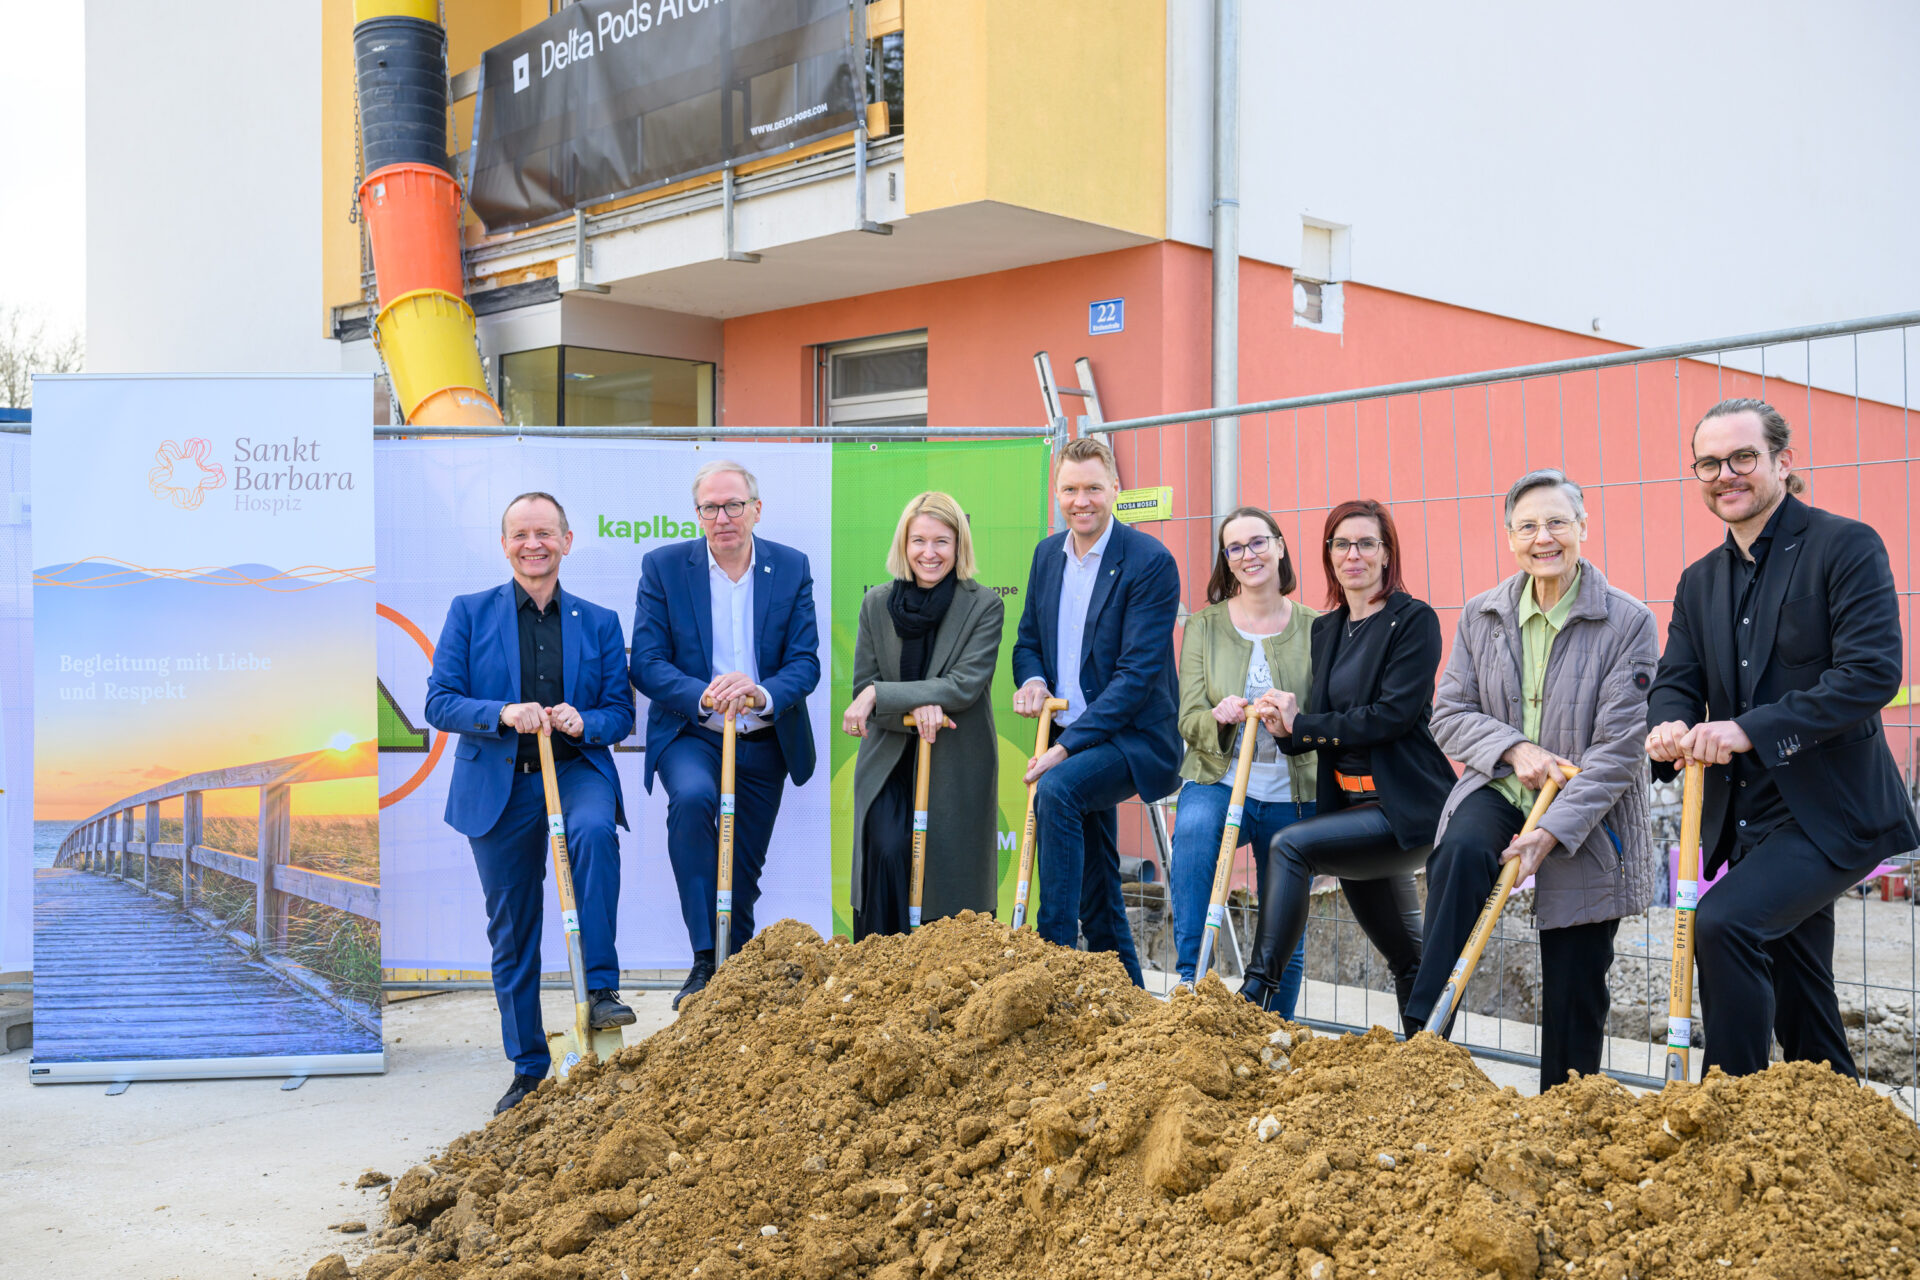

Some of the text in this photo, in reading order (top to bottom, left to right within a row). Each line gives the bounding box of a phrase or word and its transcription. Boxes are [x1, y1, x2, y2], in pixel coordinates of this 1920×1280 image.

[541, 26, 594, 78] Delta
[598, 0, 652, 51] Pods
[750, 102, 828, 136] WWW.DELTA-PODS.COM
[1097, 303, 1116, 323] 22
[234, 436, 321, 462] Sankt
[233, 465, 355, 490] Barbara
[234, 494, 302, 516] Hospiz
[1118, 500, 1157, 510] ROSA MOSER
[60, 652, 272, 678] Begleitung mit Liebe
[59, 681, 187, 704] und Respekt
[1676, 910, 1687, 949] OFFNER
